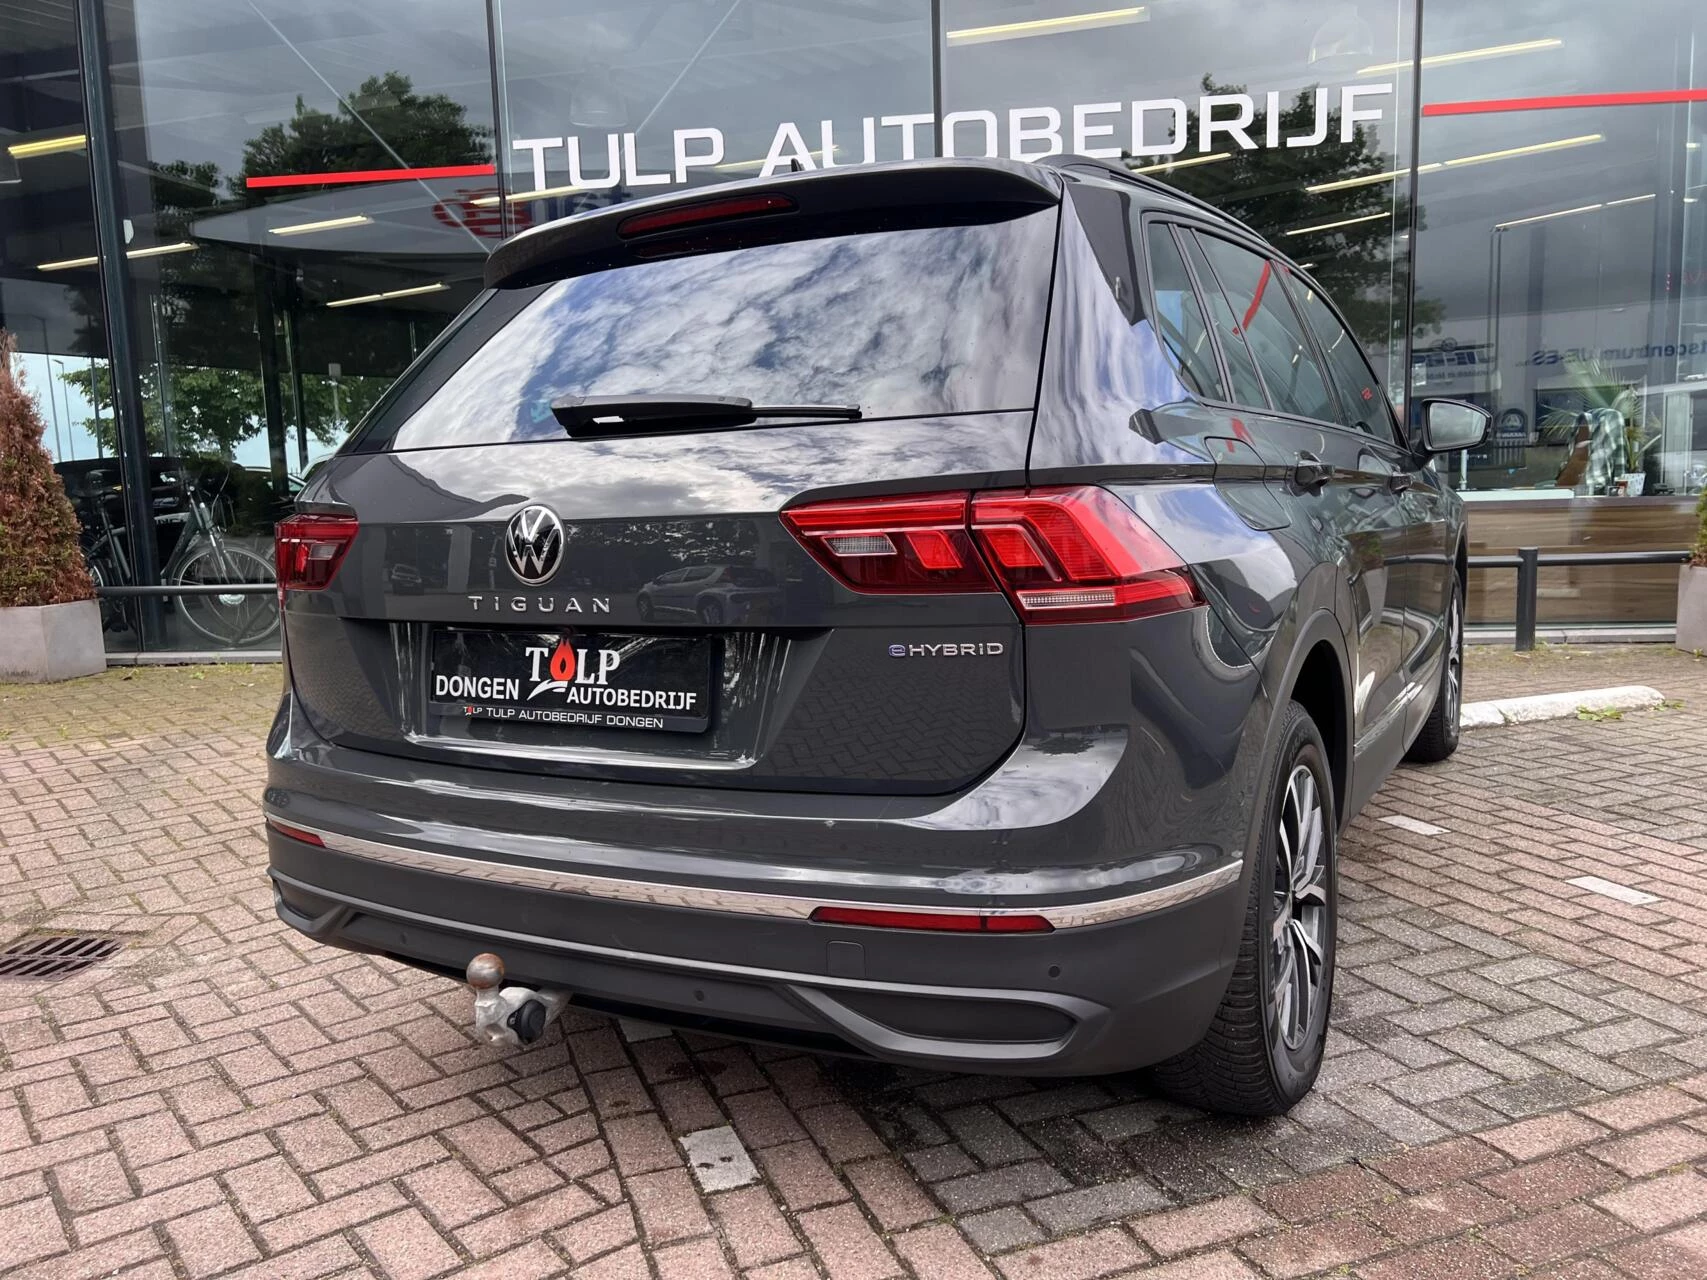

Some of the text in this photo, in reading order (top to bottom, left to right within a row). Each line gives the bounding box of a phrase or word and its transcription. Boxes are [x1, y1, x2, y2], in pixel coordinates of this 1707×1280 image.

[512, 83, 1393, 192] TULP AUTOBEDRIJF
[467, 595, 610, 613] TIGUAN
[436, 675, 697, 710] DONGEN AUTOBEDRIJF
[486, 707, 515, 719] TULP
[518, 710, 602, 725] AUTOBEDRIJF
[606, 715, 664, 728] DONGEN
